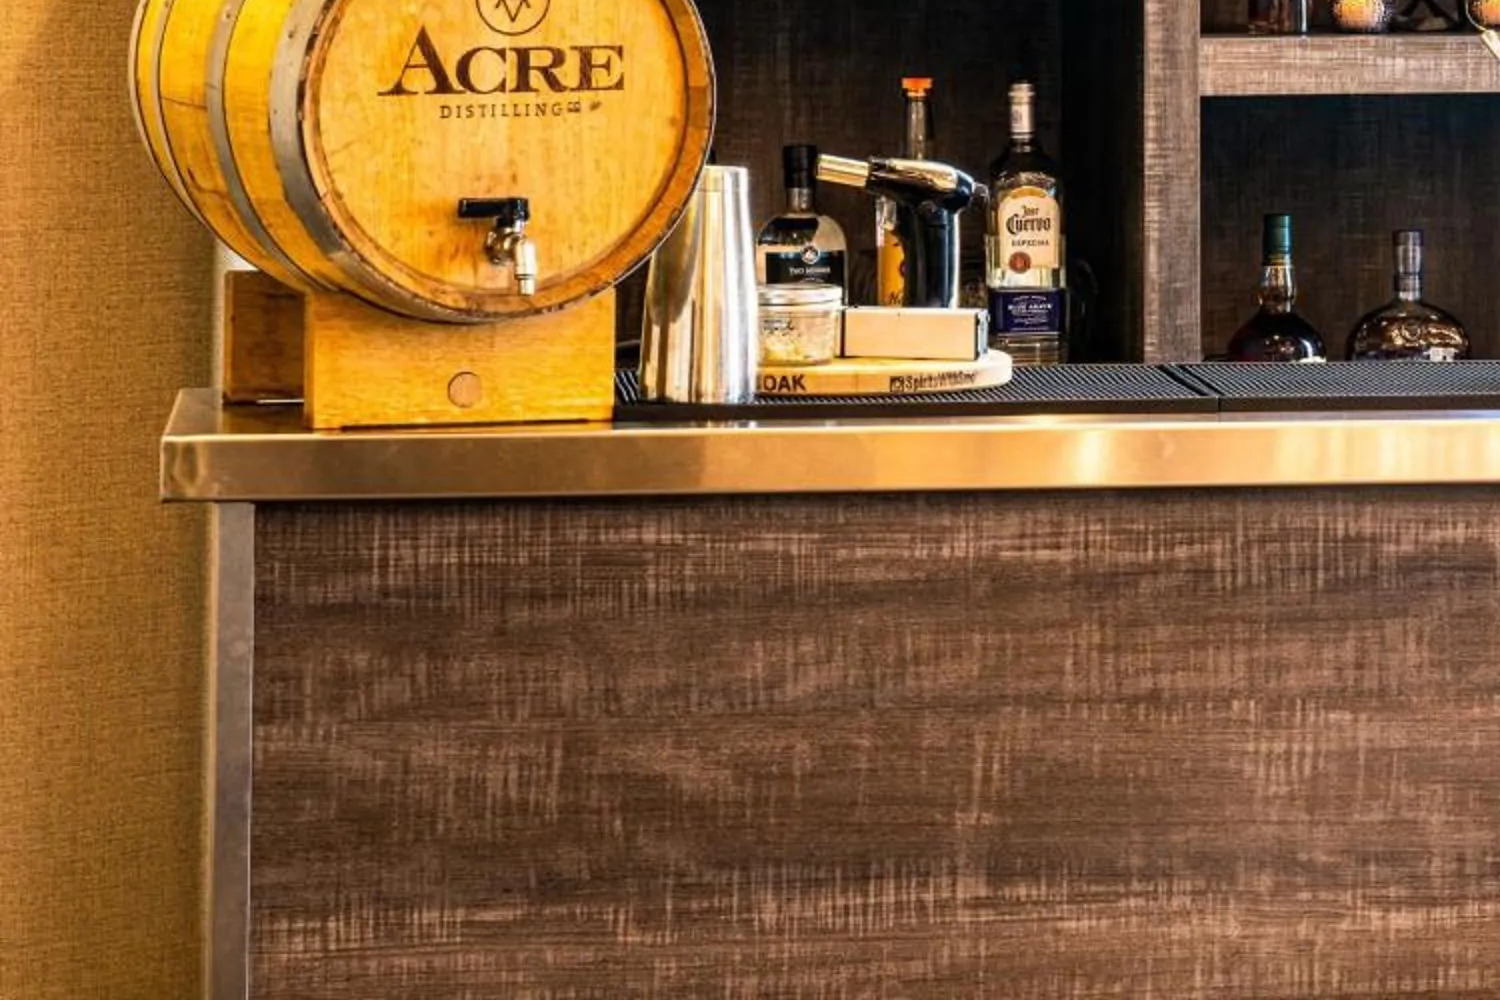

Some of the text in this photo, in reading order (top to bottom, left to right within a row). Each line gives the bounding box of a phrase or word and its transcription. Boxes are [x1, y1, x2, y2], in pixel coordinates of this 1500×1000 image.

[377, 24, 625, 97] ACRE
[439, 101, 564, 120] DISTILLING
[1005, 213, 1051, 235] Cuervo
[763, 374, 807, 392] OAK
